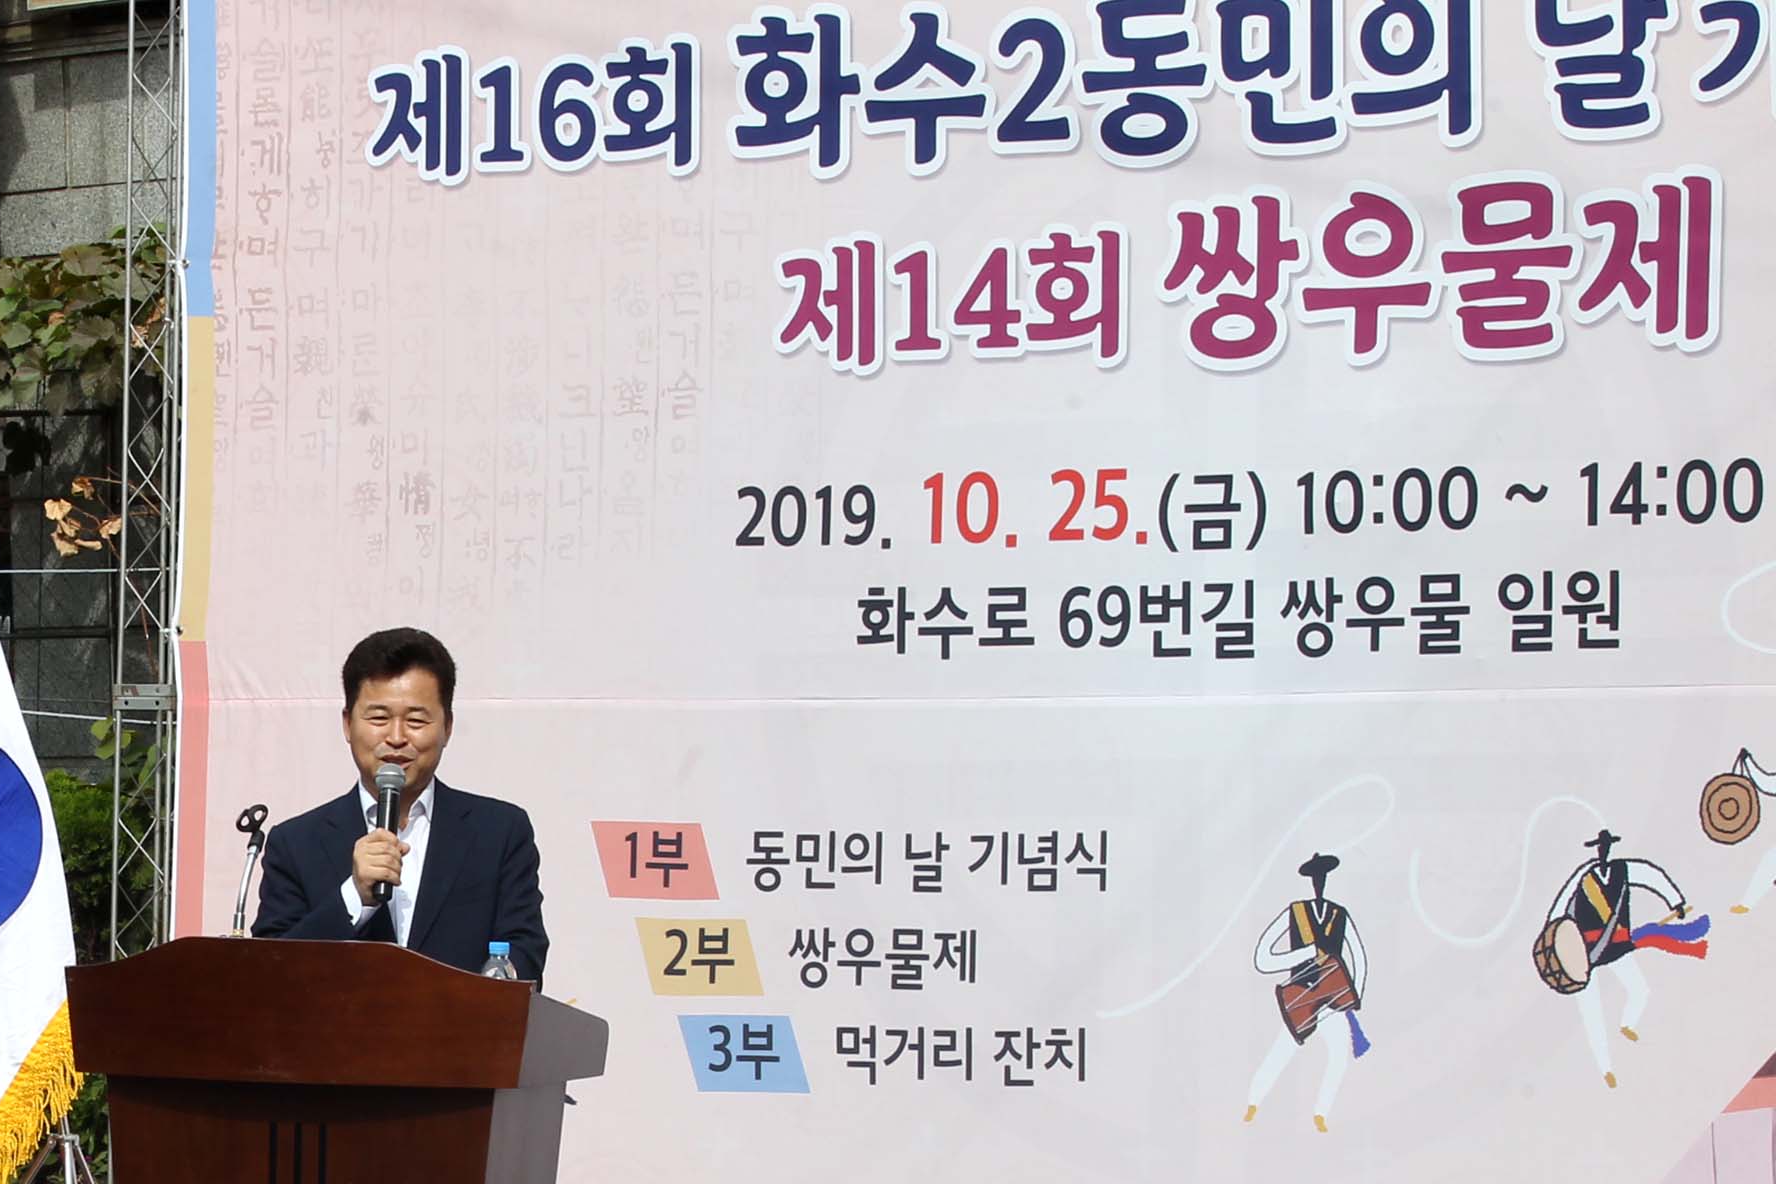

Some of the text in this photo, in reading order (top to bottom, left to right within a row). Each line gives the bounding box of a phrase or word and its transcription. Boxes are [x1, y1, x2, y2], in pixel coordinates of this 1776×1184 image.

[371, 42, 693, 178] 제16회
[735, 0, 1472, 168] 화수2동민의
[1534, 0, 1670, 129] 날
[779, 176, 1713, 367] 제14회 쌍우물제
[735, 484, 892, 550] 2019.
[923, 471, 1018, 548] 10.
[1296, 466, 1479, 535] 10:00
[1579, 457, 1764, 527] 14:00
[855, 569, 1621, 660] 화수로 69번길 쌍우물 일원
[624, 830, 1108, 893] 1부 동민의 날 기념식
[662, 926, 978, 991] 2부 쌍우물제
[708, 1022, 1087, 1088] 3부 먹거리 잔치
